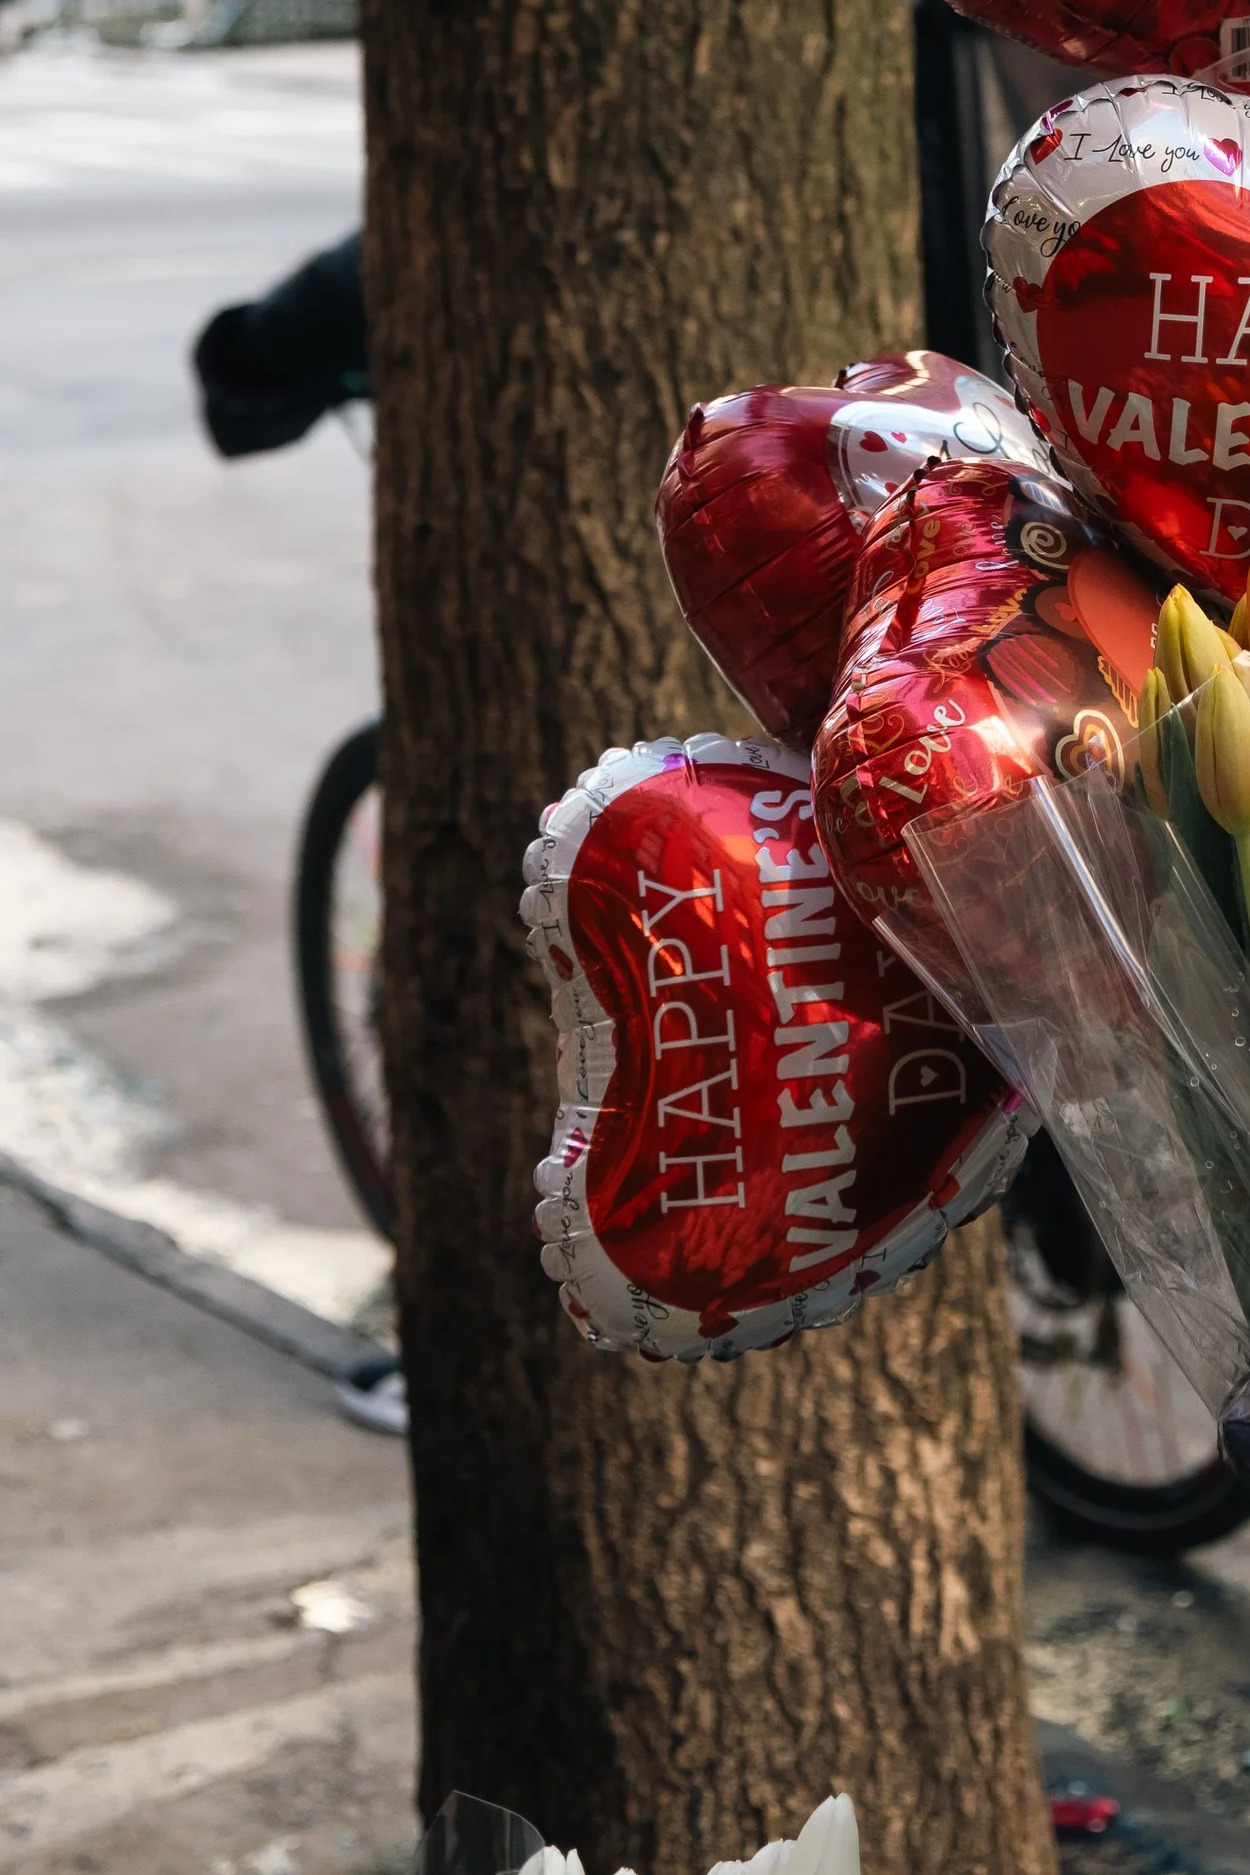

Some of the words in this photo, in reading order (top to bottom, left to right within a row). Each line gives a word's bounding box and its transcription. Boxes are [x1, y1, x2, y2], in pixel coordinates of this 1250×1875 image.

[1063, 133, 1091, 161] I
[1091, 134, 1156, 163] Love
[1161, 144, 1200, 173] you
[998, 195, 1048, 232] Love
[879, 699, 967, 805] Love
[637, 869, 745, 1214] HAPPY
[750, 789, 859, 1274] VALENTINE'S
[575, 1032, 590, 1102] Love
[561, 1172, 576, 1212] you
[556, 1218, 576, 1271] Love
